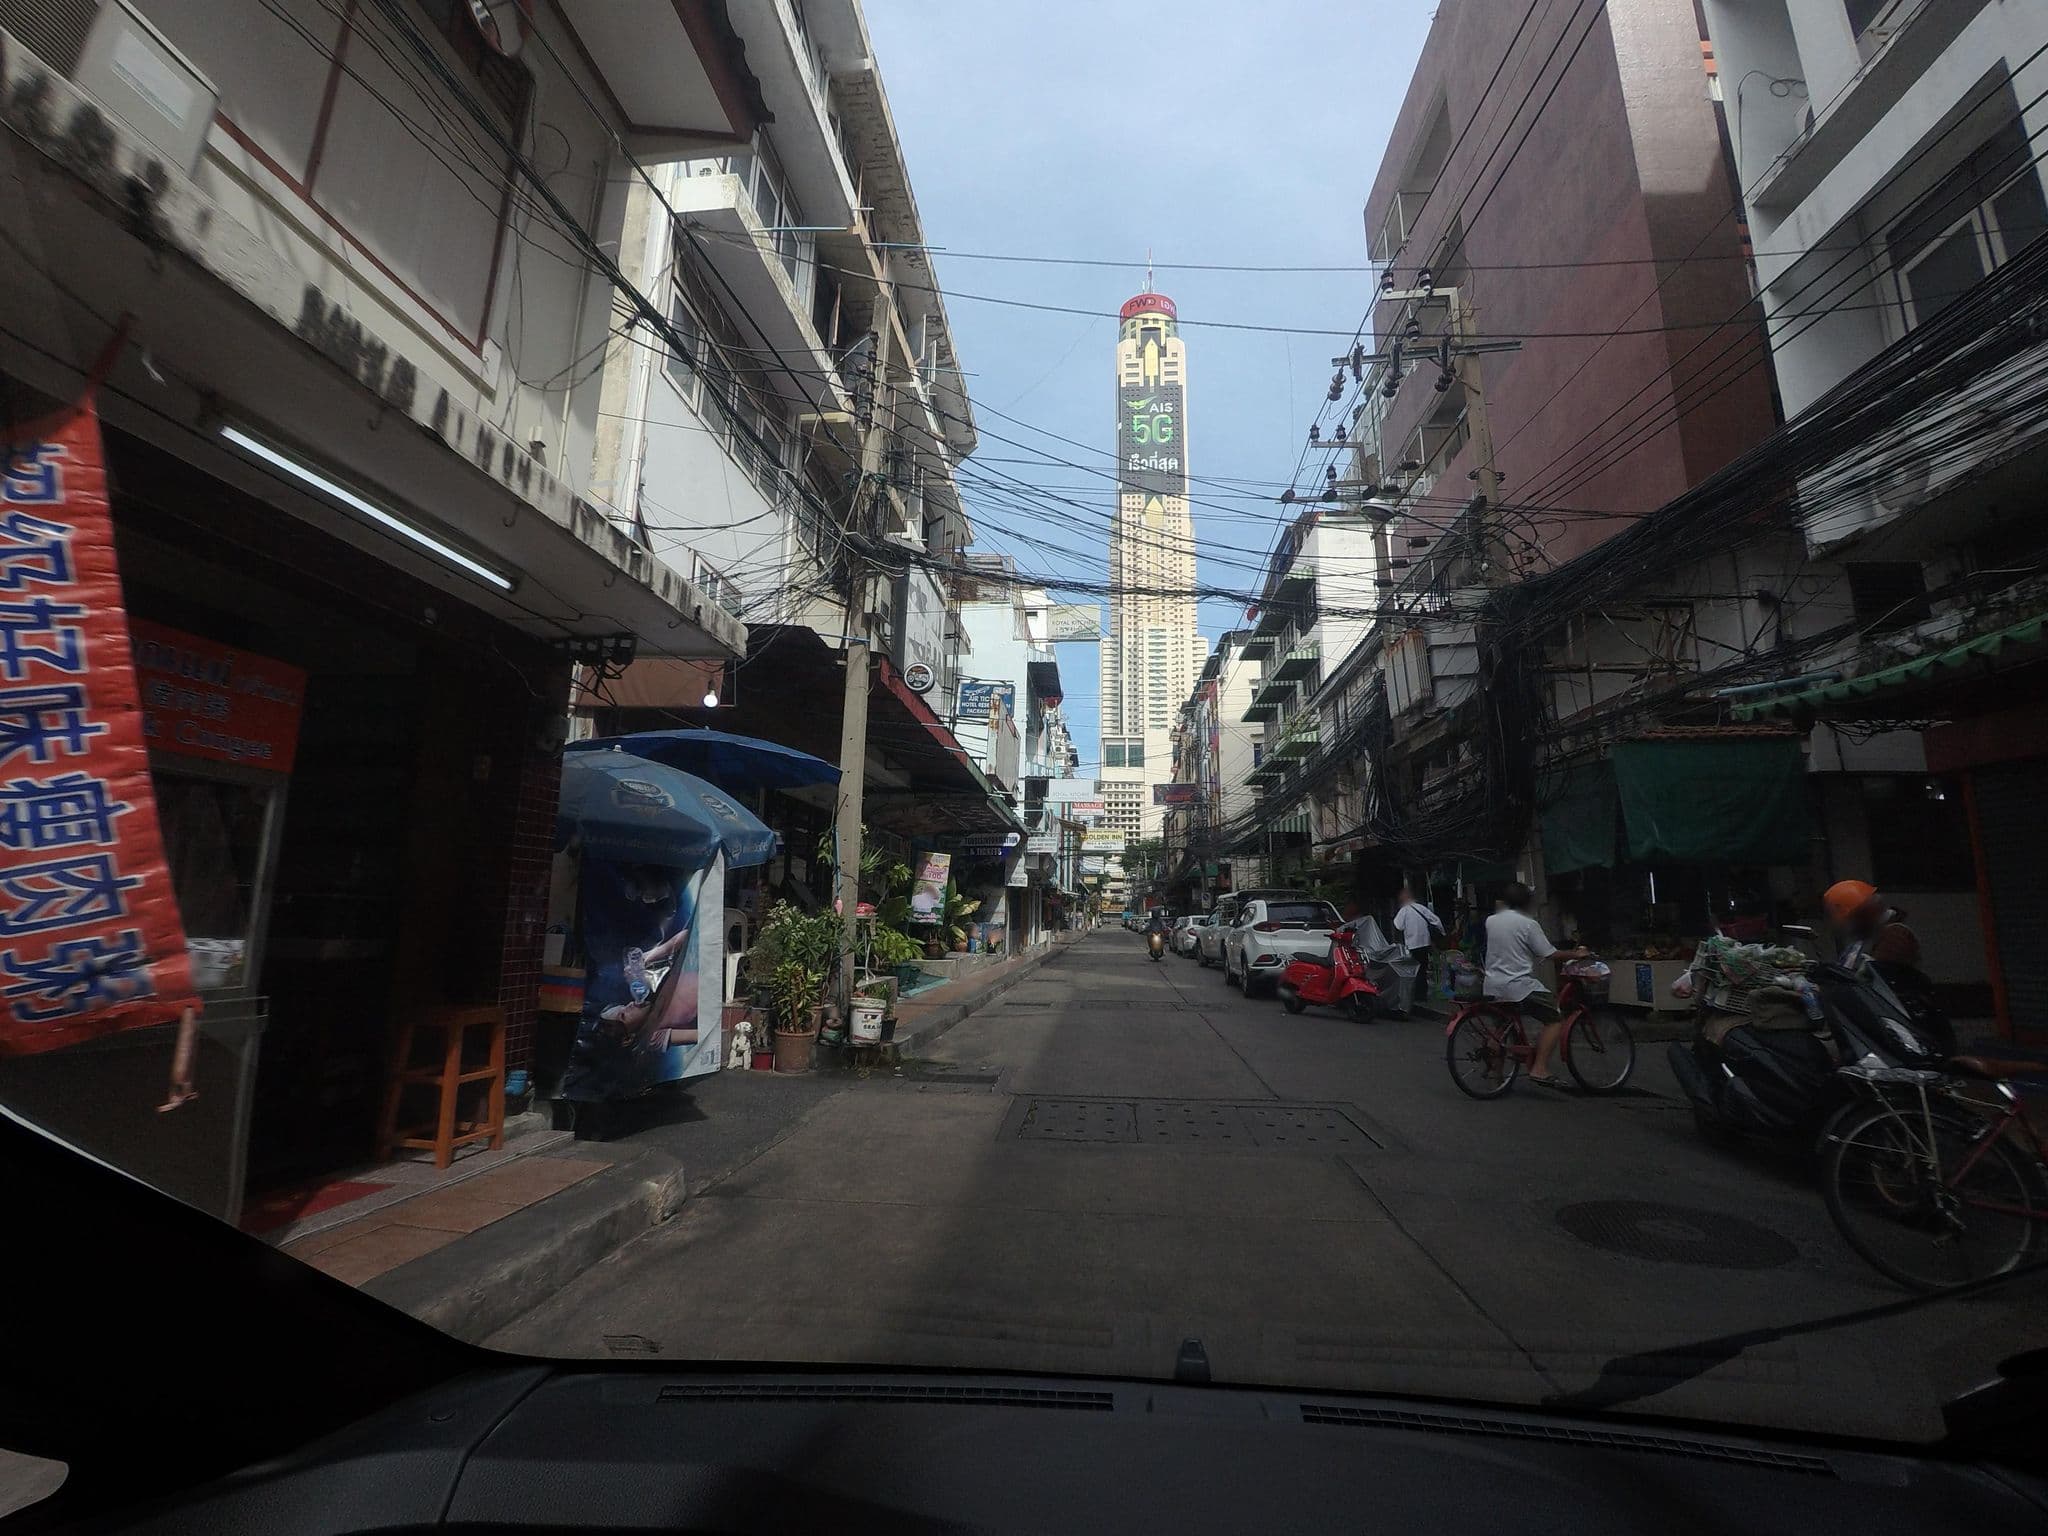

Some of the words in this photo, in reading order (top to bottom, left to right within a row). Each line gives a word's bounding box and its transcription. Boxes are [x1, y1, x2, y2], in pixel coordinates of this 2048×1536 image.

[1129, 297, 1157, 311] FWD
[1149, 403, 1174, 413] AIS
[1132, 415, 1174, 444] 5G
[1128, 452, 1179, 474] เร็วที่สุด
